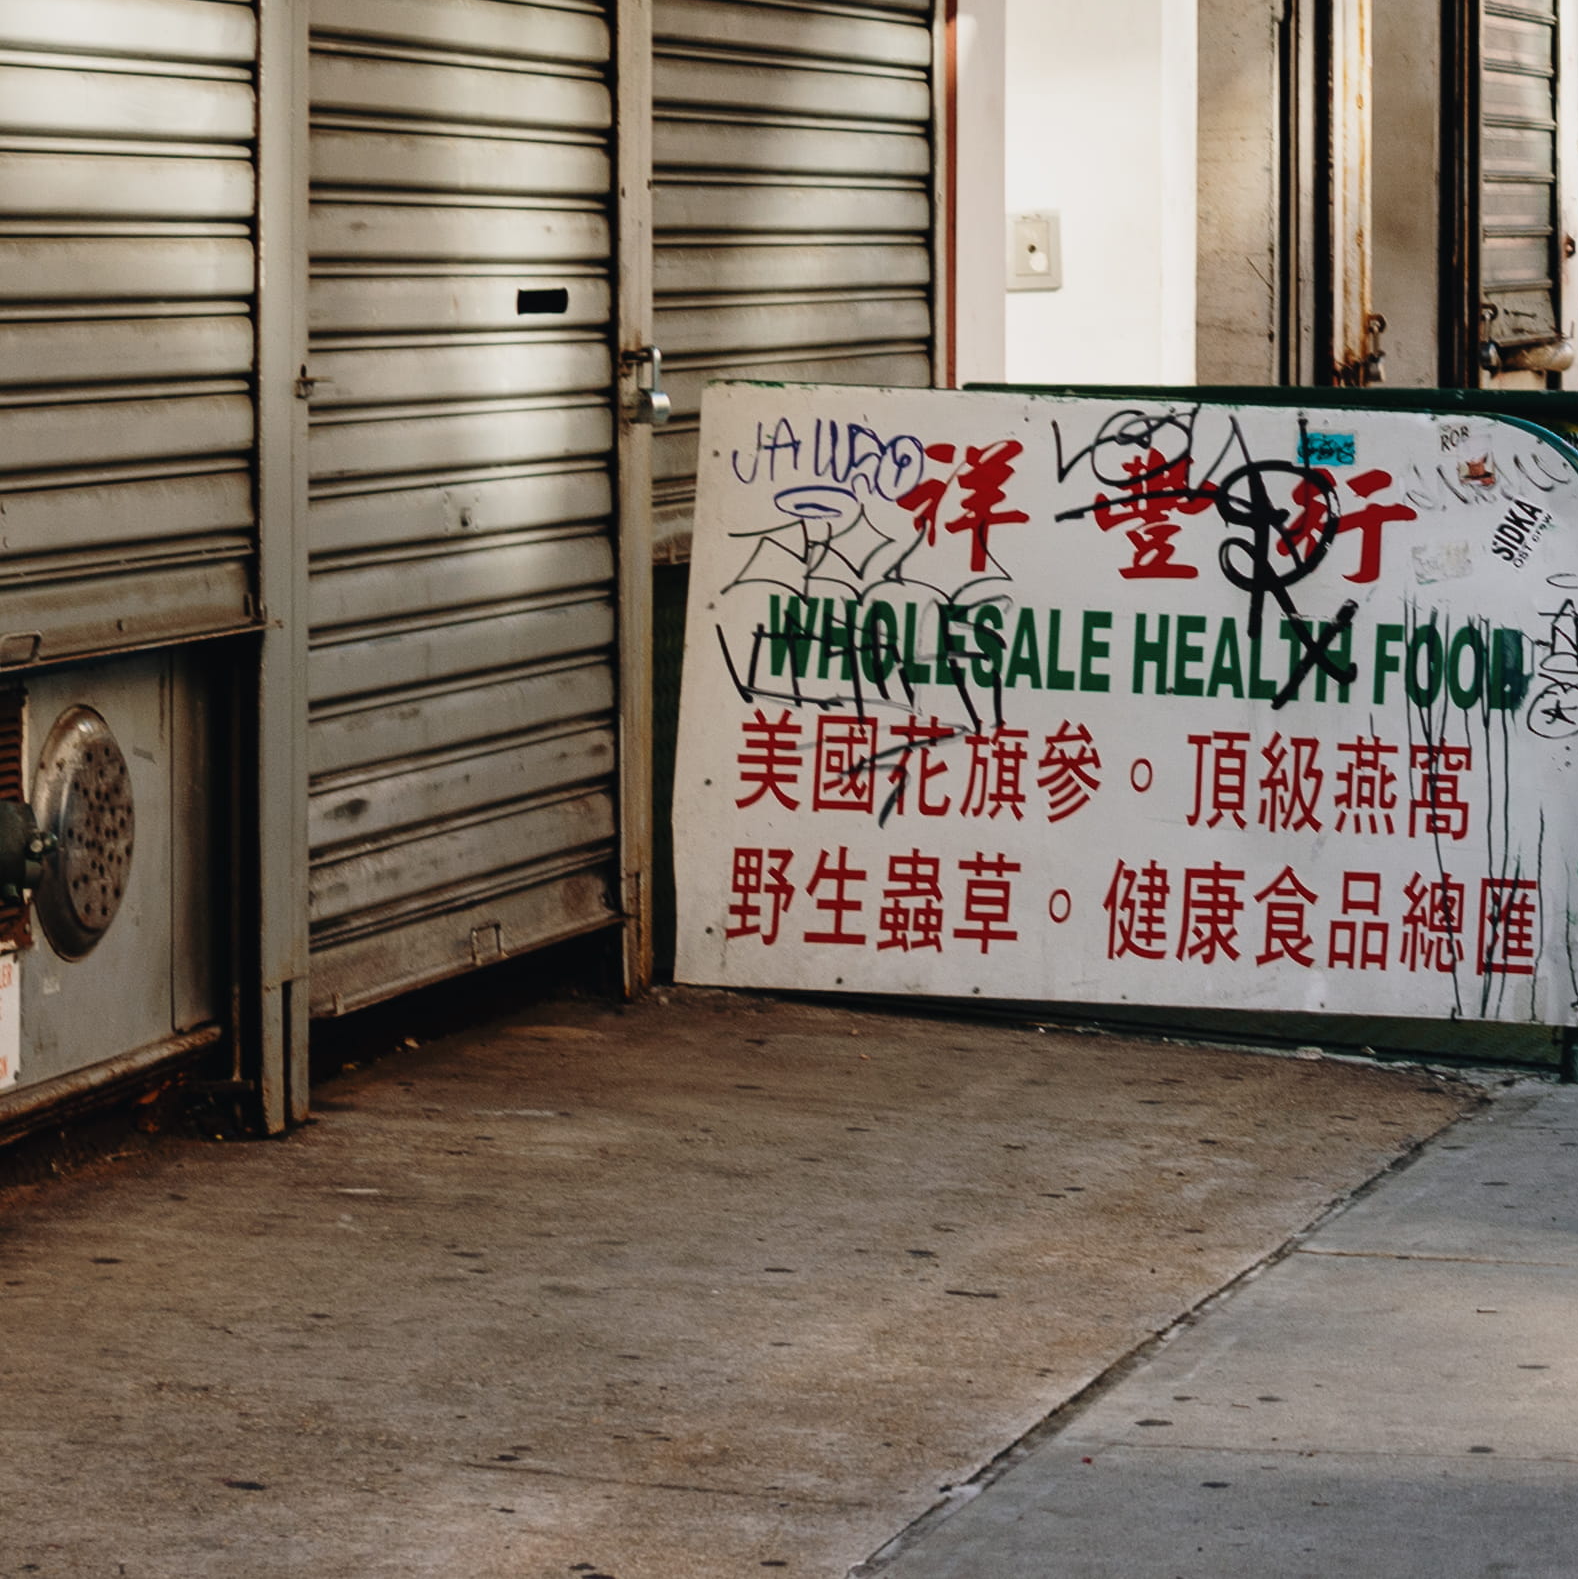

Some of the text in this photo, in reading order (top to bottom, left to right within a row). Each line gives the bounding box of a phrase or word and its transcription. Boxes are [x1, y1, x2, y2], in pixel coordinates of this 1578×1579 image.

[1491, 494, 1543, 563] SIDKA
[768, 593, 1111, 693] WHOLESALE
[1131, 613, 1353, 705] HEALTH
[1374, 622, 1528, 713] FOOD
